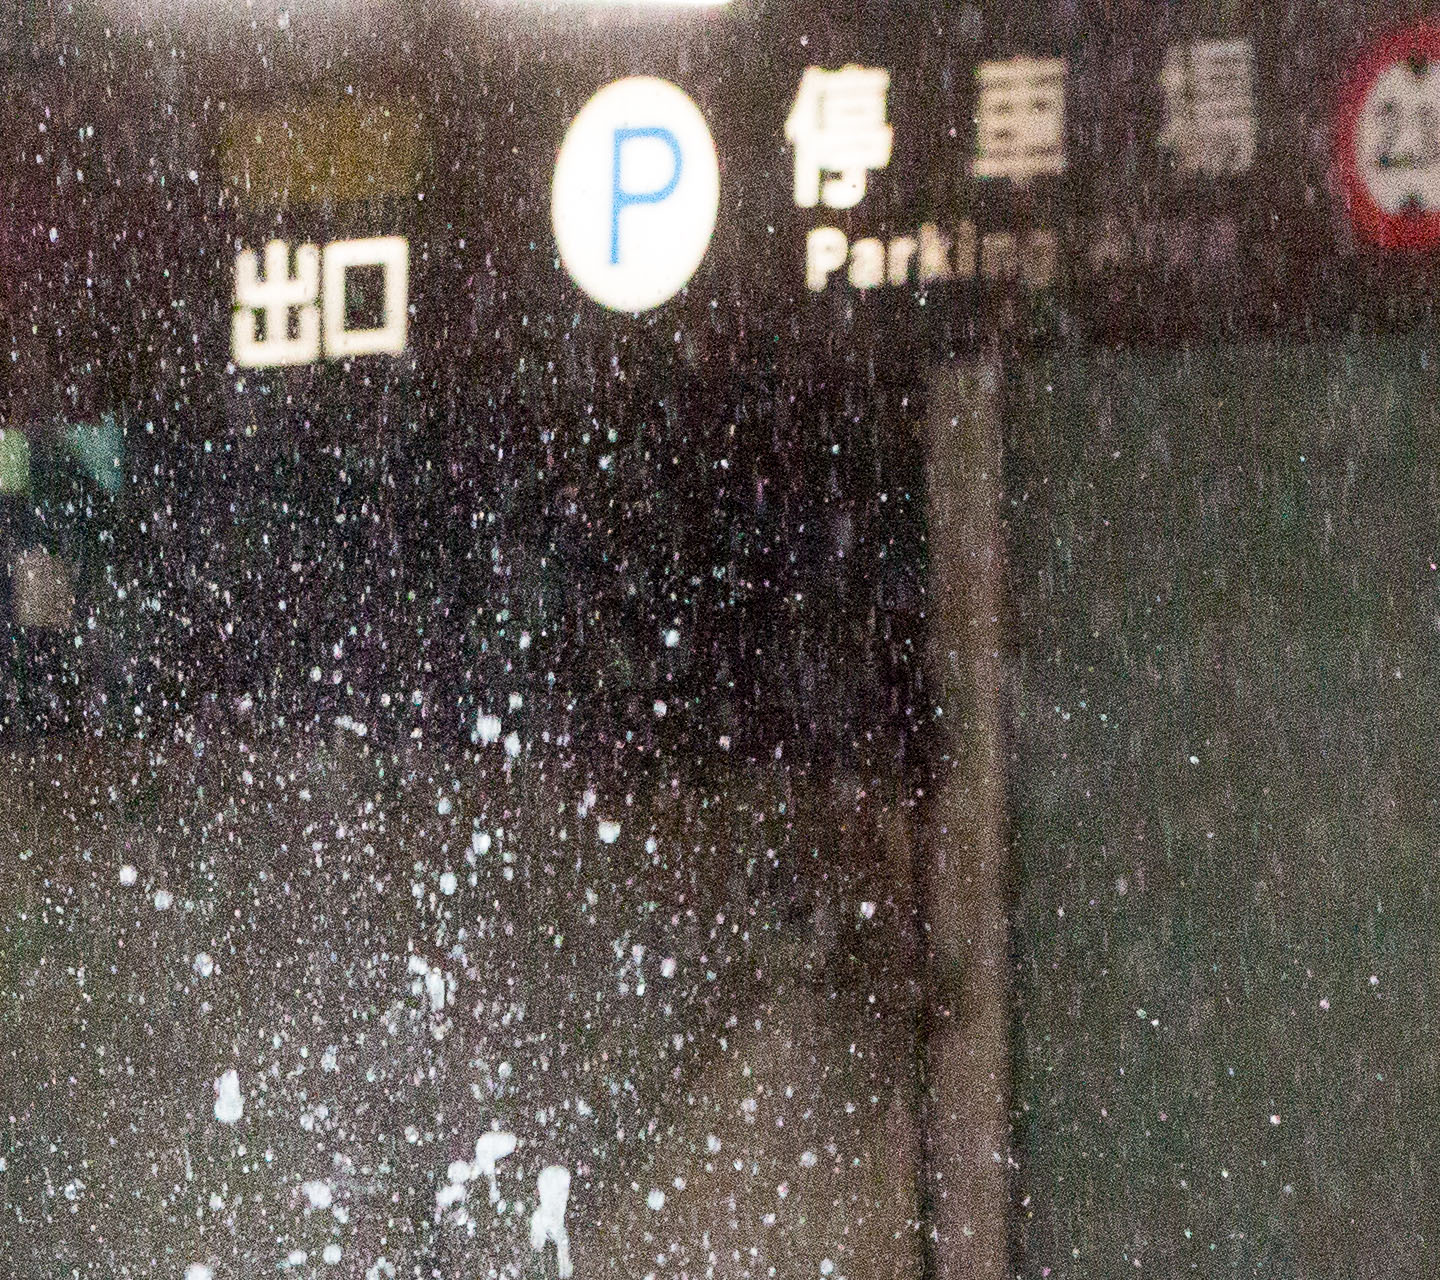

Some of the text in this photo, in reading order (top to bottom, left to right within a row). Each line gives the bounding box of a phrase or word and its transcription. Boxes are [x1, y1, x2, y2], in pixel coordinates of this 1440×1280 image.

[609, 127, 683, 265] P
[805, 221, 1056, 292] Parking
[231, 236, 409, 366] 出口
